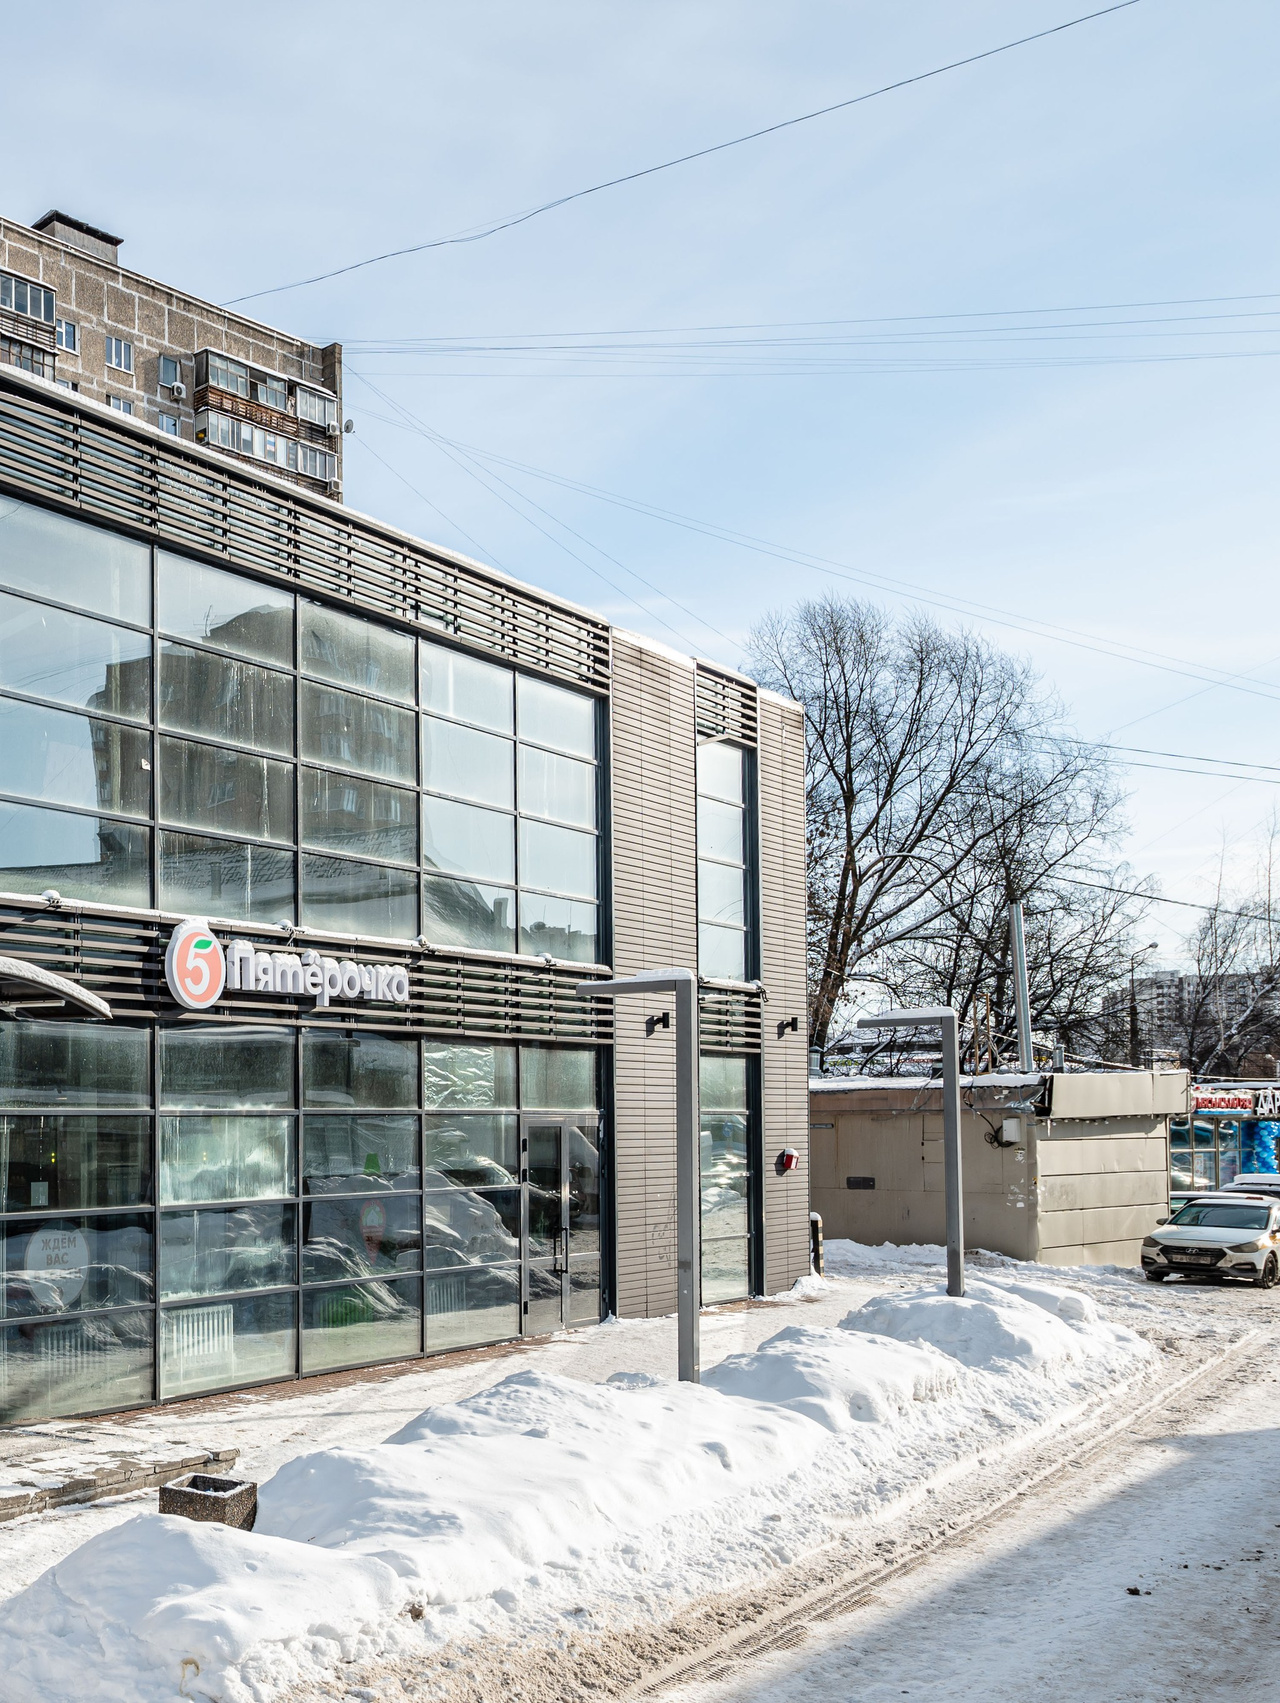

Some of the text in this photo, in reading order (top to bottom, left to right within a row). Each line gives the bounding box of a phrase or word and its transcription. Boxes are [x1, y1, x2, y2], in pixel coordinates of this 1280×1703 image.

[185, 937, 409, 1006] 5 Пятёрочка
[41, 1234, 77, 1251] ЖДЁМ
[46, 1253, 69, 1266] ВАС
